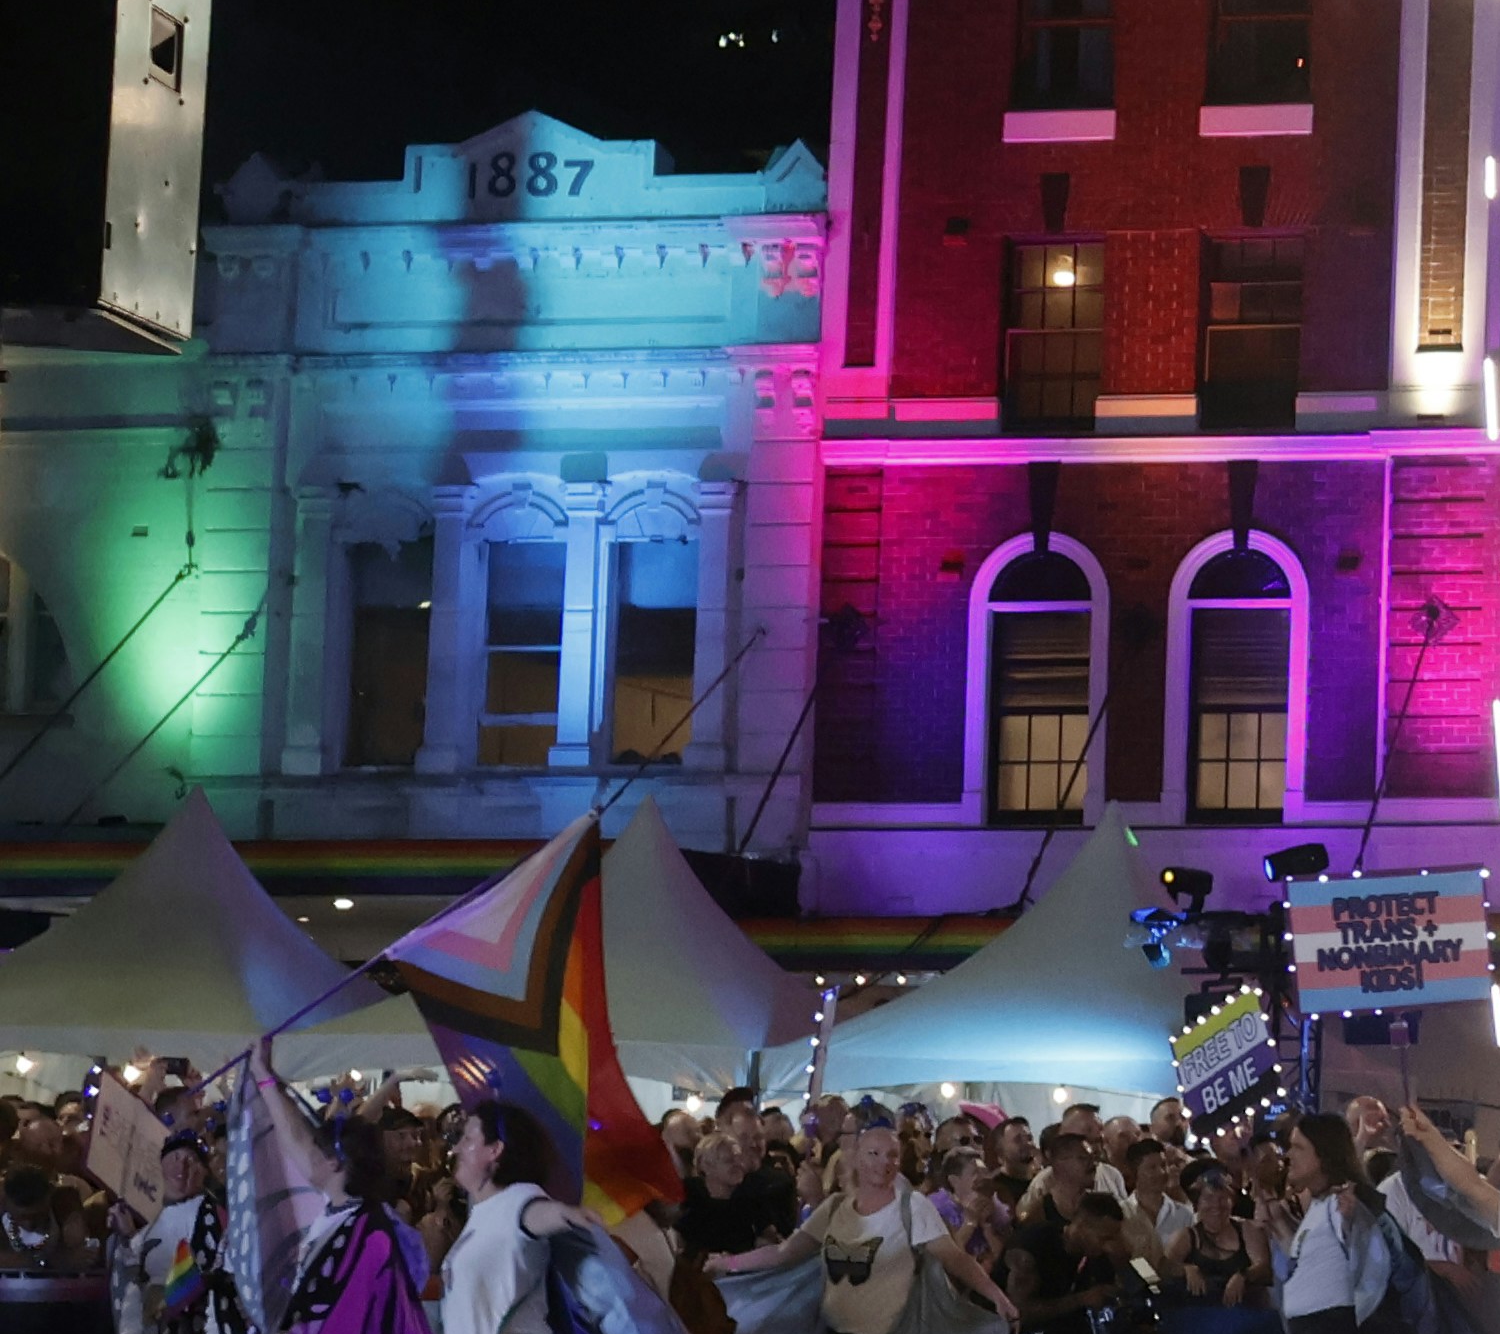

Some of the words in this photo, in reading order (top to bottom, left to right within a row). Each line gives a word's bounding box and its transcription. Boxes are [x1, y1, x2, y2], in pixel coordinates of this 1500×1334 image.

[468, 151, 595, 200] 1887
[1332, 890, 1439, 921] PROTECT
[1336, 917, 1418, 945] TRANS
[1316, 938, 1463, 972] NONBINARY
[1180, 1031, 1232, 1085] FREE
[1229, 1011, 1258, 1049] TO
[1202, 1076, 1230, 1114] BE
[1228, 1056, 1260, 1097] ME
